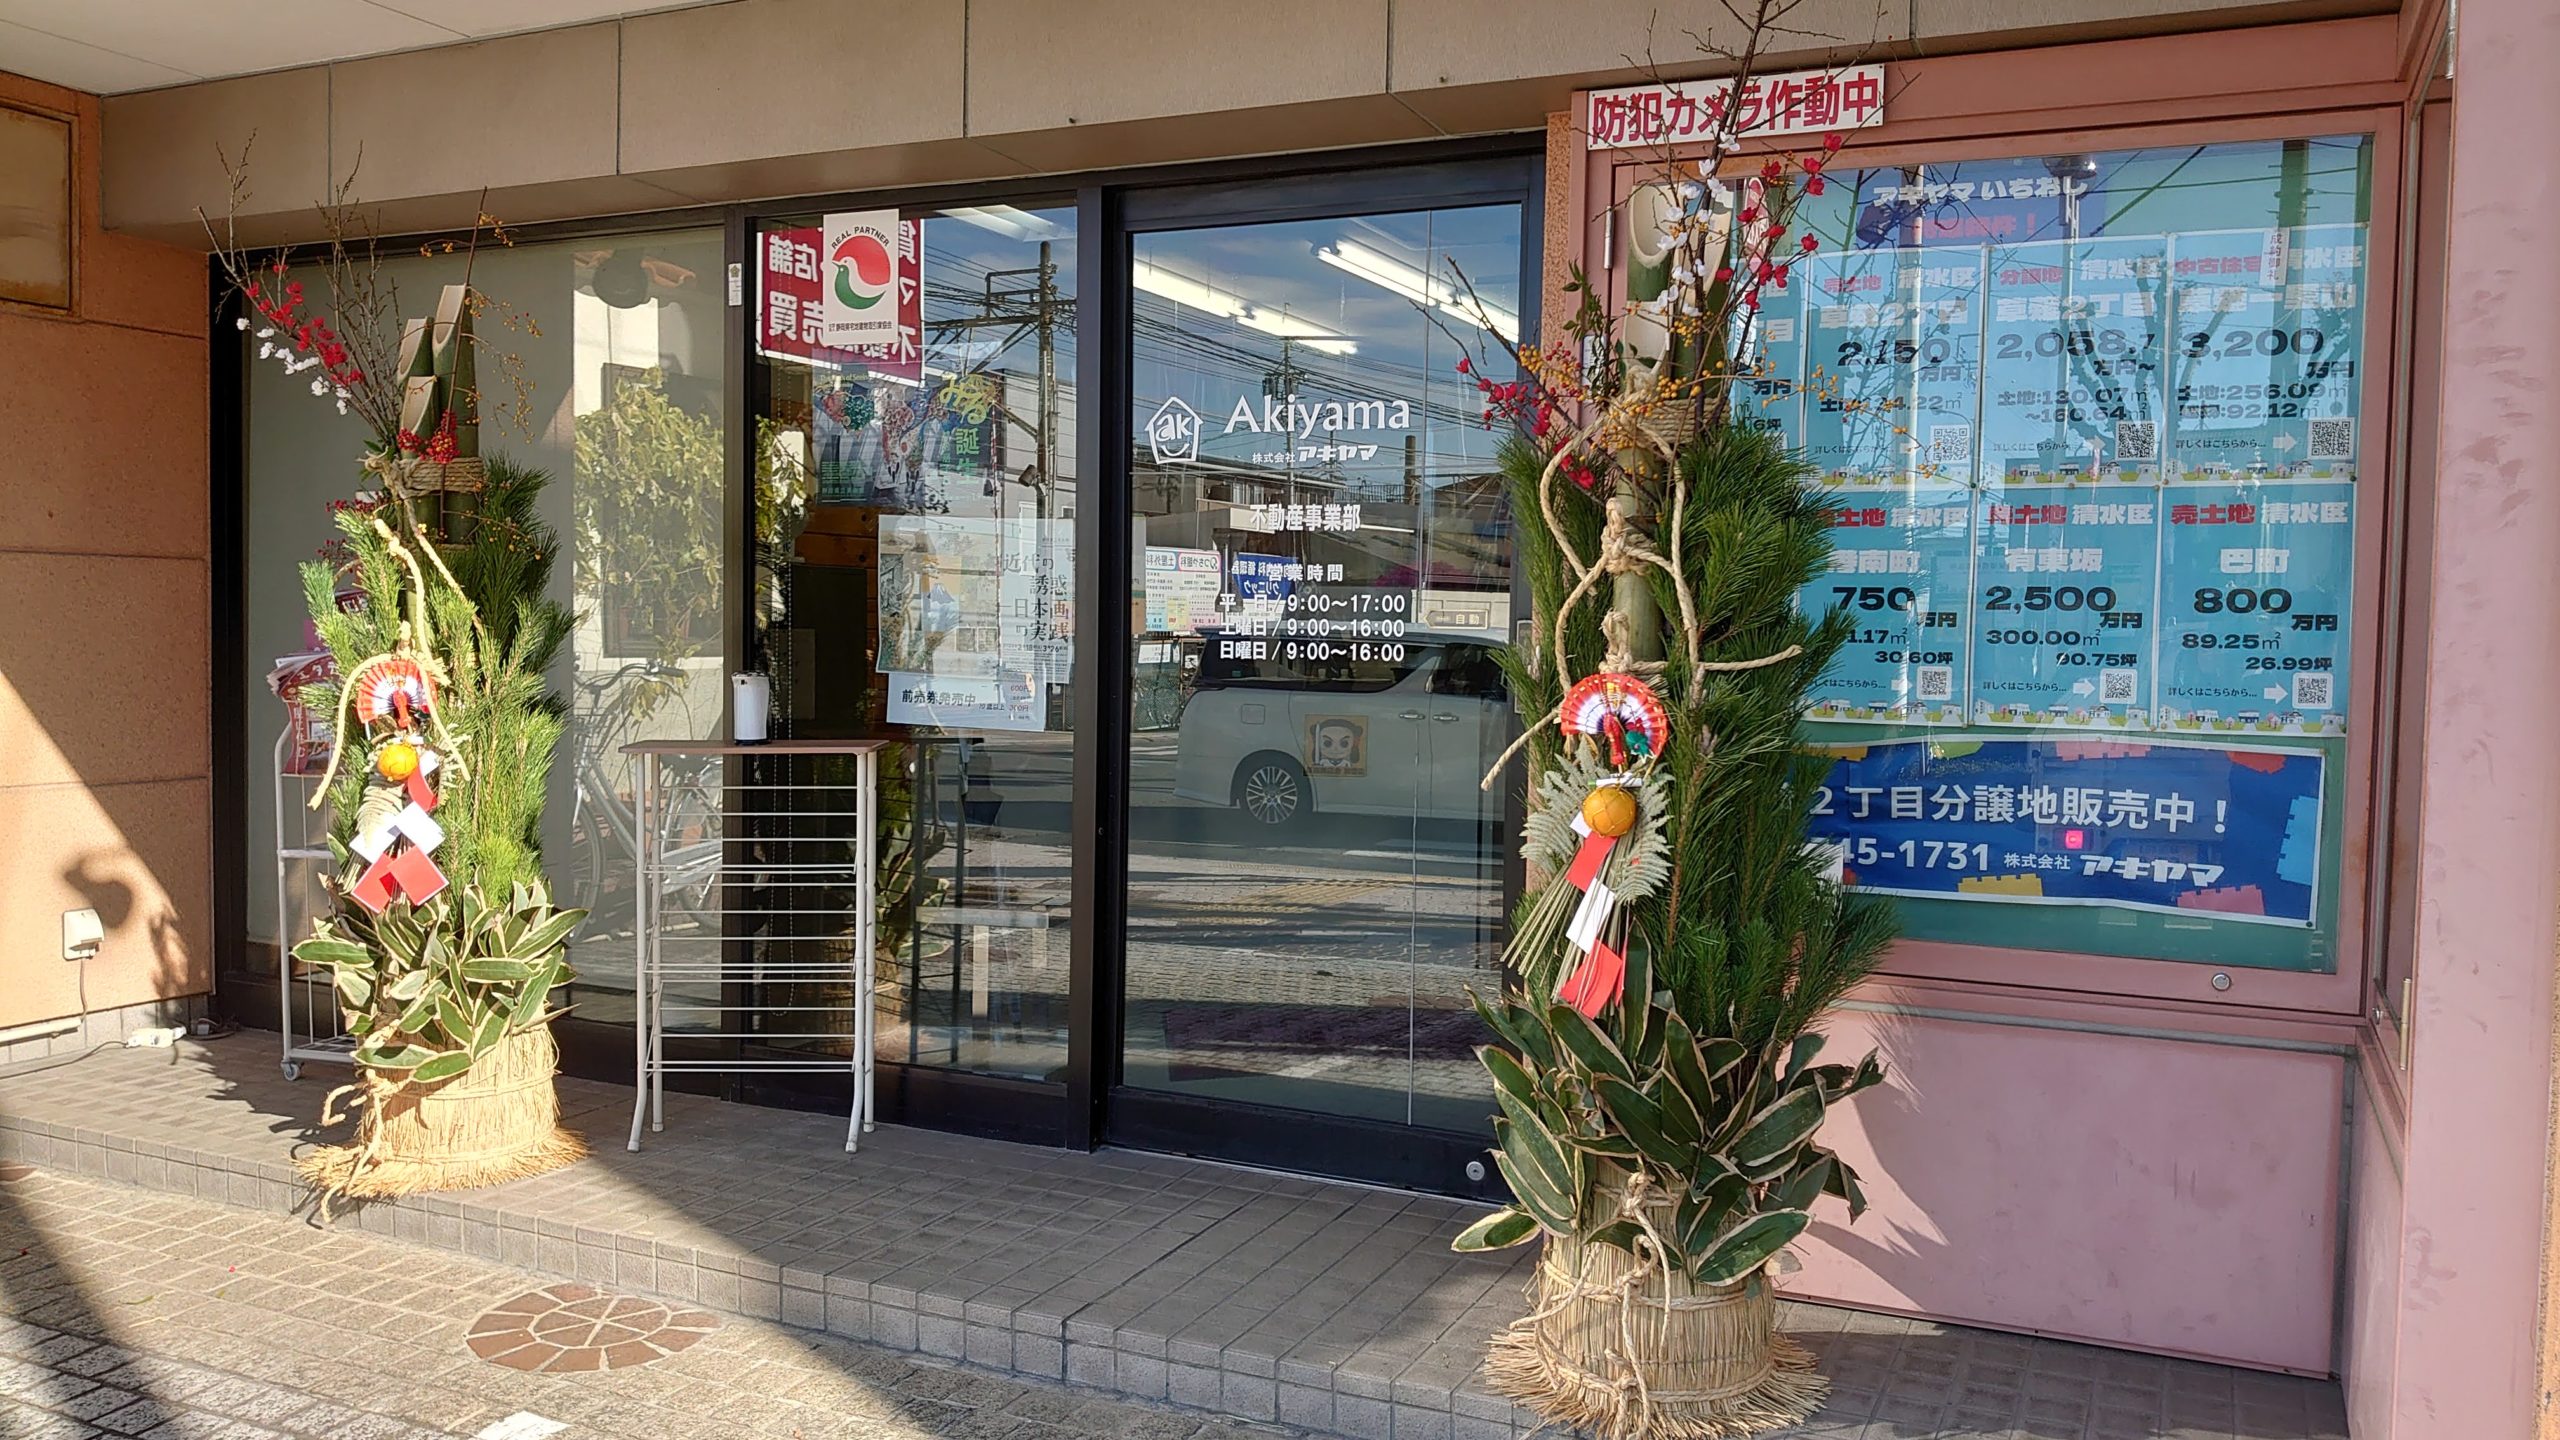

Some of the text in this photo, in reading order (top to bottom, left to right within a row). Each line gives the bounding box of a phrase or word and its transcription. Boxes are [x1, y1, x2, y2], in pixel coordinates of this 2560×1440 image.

[1592, 71, 1880, 145] 防犯カメラ作動中
[831, 231, 851, 250] REAL
[854, 226, 890, 247] PARTNER
[1997, 329, 2156, 361] 2,058.7
[2182, 327, 2324, 359] 3,200
[1919, 366, 1961, 382] 万円
[2306, 360, 2355, 379] 万円
[1223, 394, 1410, 439] Akiyama
[1252, 445, 1379, 464] 株式会社 アキヤマ
[1250, 504, 1361, 532] 不動産事業部
[1989, 503, 2154, 525] 売土地 清水区
[2170, 501, 2349, 525] 売土地 清水区
[2005, 548, 2103, 573] 有東坂
[2220, 548, 2290, 574] 巴町
[1268, 563, 1344, 583] 営業時間
[1833, 586, 1916, 612] 750
[1985, 585, 2117, 615] 2,500
[2193, 587, 2293, 614] 800
[1917, 611, 1958, 628] 万円
[2099, 612, 2143, 629] 万円
[2291, 614, 2338, 631] 万円
[1875, 651, 1953, 665] 3060坪
[2056, 653, 2137, 667] 90.75坪
[2245, 657, 2333, 672] 26.99坪
[1811, 679, 1887, 689] しくはこちらから...
[2003, 852, 2071, 871] 株式会社
[2079, 854, 2226, 887] アキヤマ
